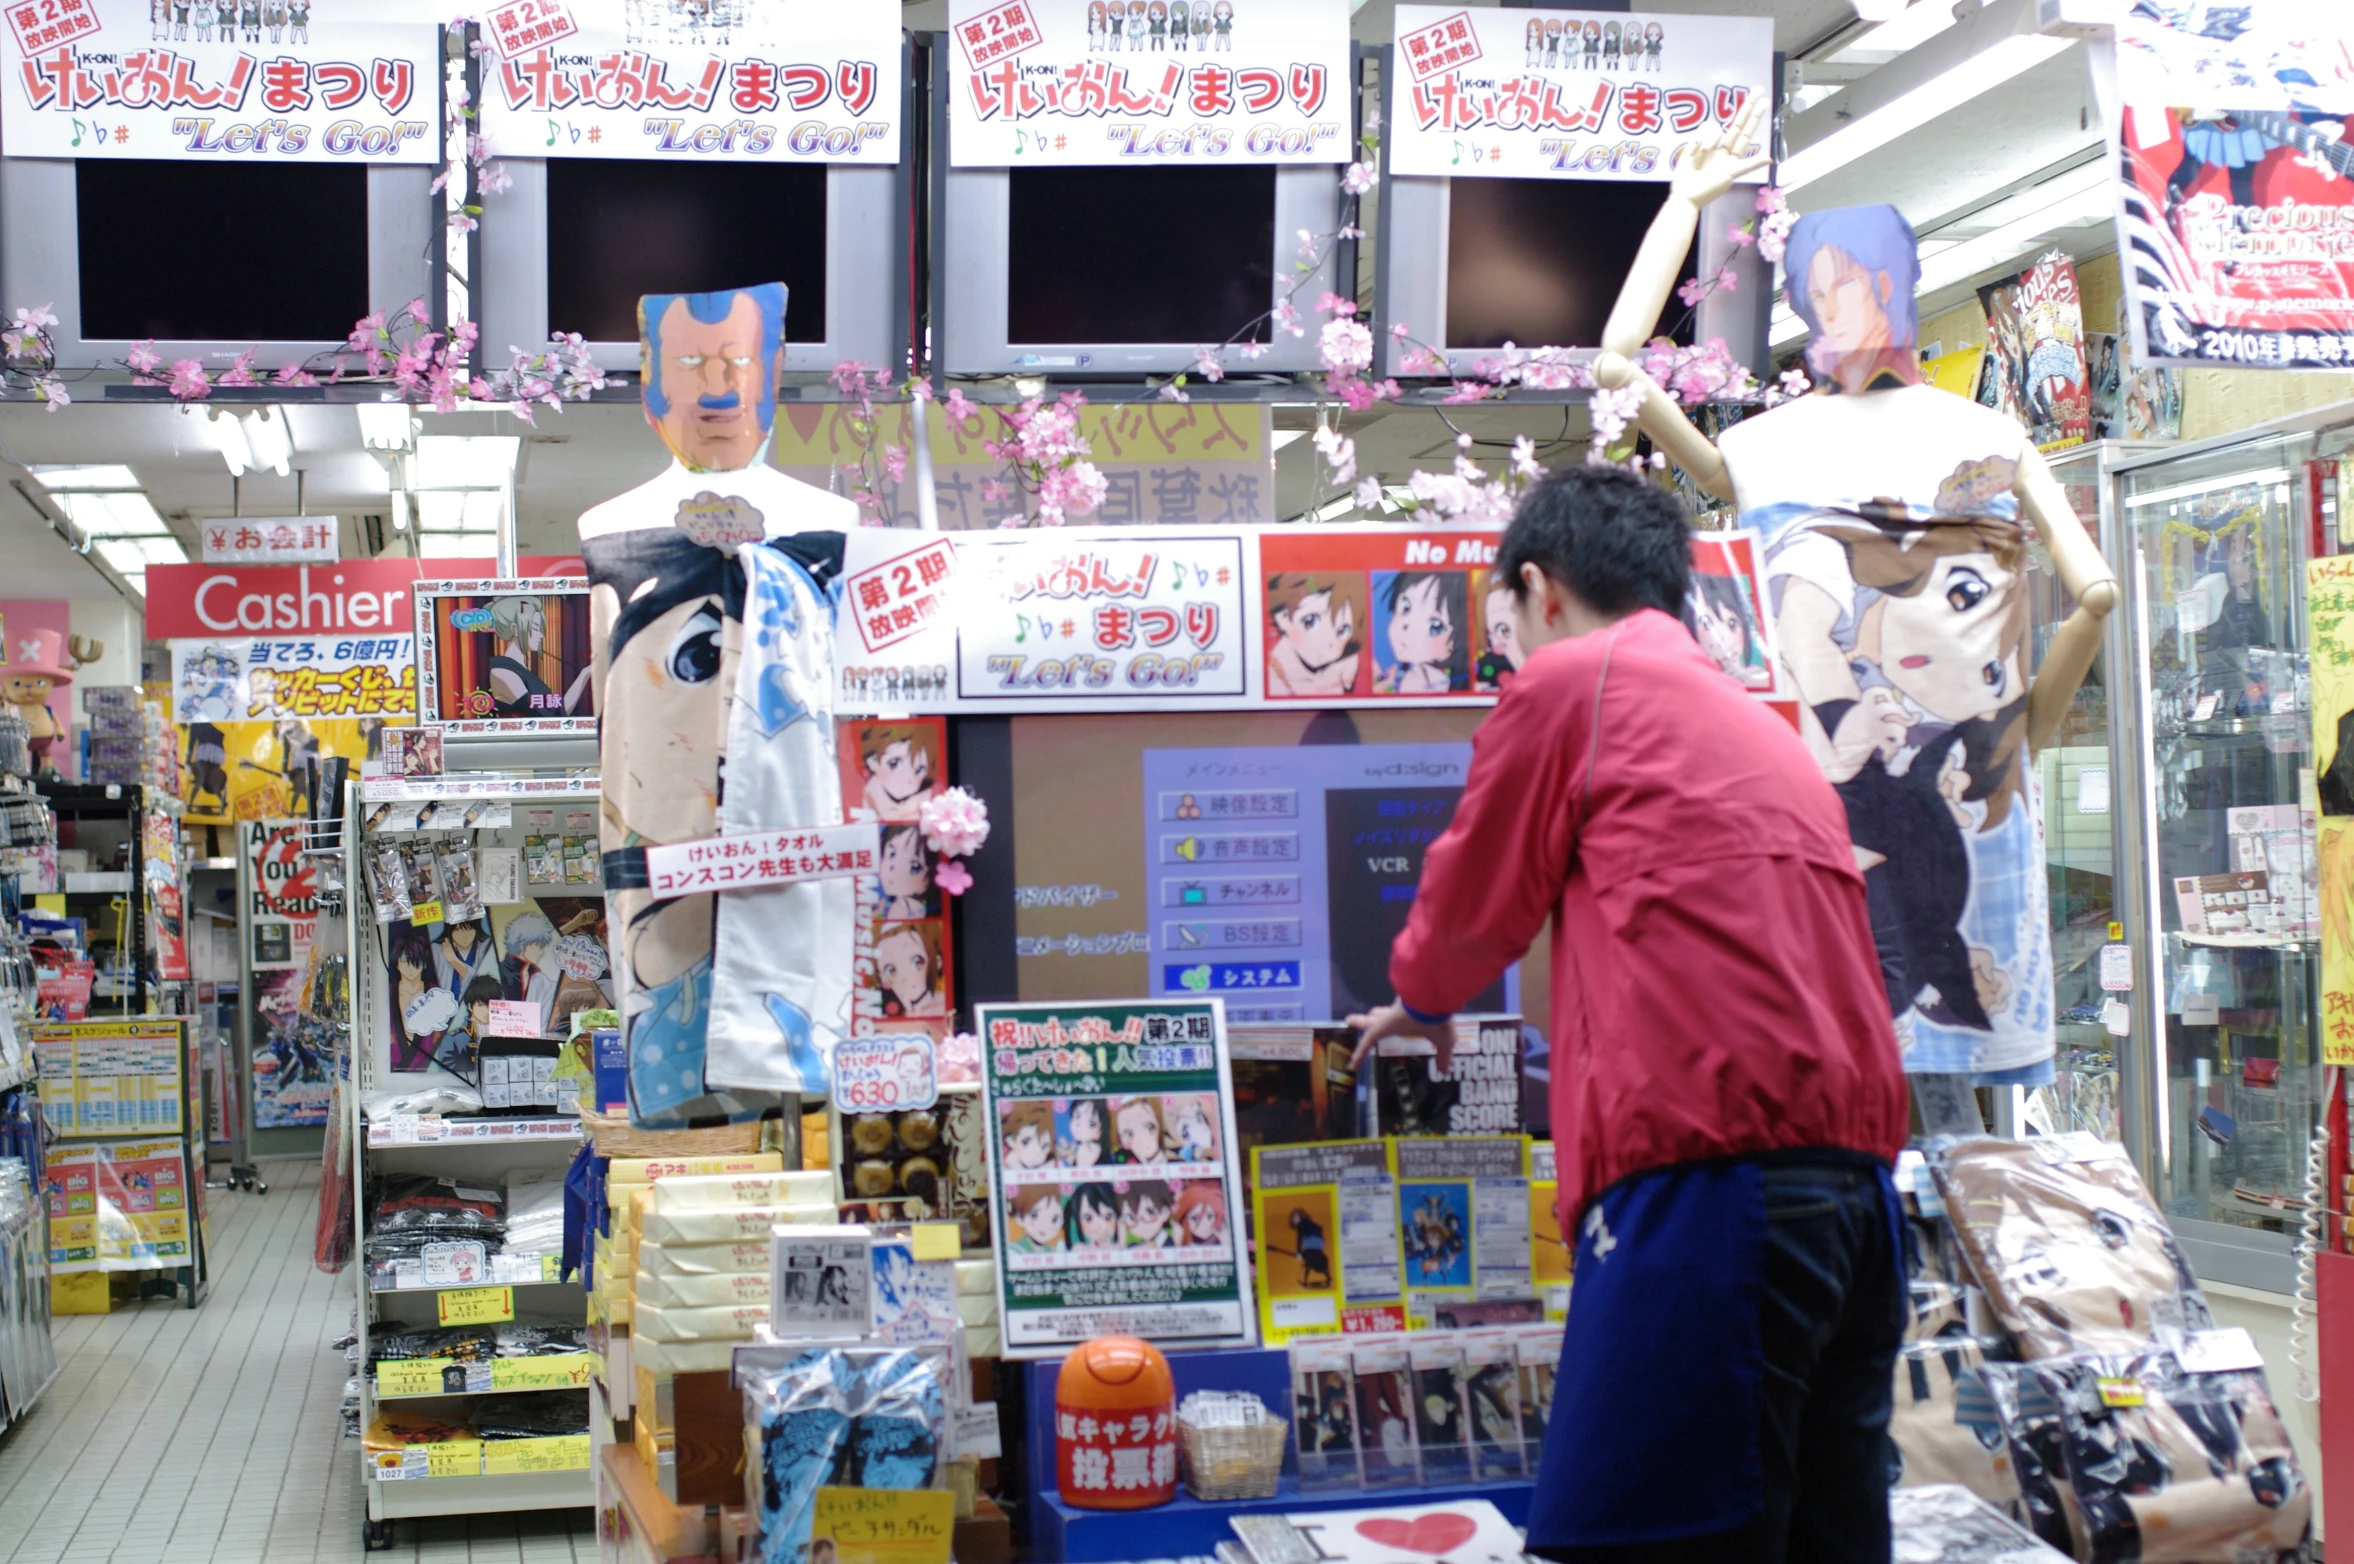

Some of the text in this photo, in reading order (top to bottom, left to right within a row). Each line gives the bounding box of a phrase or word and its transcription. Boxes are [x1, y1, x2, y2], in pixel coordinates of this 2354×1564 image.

[963, 10, 1028, 46] 第2期
[1408, 20, 1468, 57] 第2期
[82, 54, 117, 64] K-ON!
[559, 56, 593, 66] K-ON!
[1025, 67, 1057, 75] K-ON!
[1465, 80, 1495, 88] K-ON!
[234, 524, 332, 551] お会計
[1405, 541, 1446, 564] No
[194, 572, 405, 632] Cashier
[1093, 604, 1219, 650] まつり
[529, 694, 563, 709] 月詠
[1187, 763, 1283, 777] メインメニュー
[658, 850, 873, 891] コンスコン先生も大満足
[1367, 857, 1409, 873] VCR
[1016, 886, 1117, 906] ドバイザー
[1220, 882, 1289, 898] チャンネル
[413, 905, 440, 920] 新作
[1224, 924, 1290, 943] BS設定
[1224, 967, 1292, 986] システム
[850, 1080, 898, 1105] 630
[1460, 1081, 1518, 1104] BAND
[1449, 1104, 1518, 1130] SCORE
[1058, 1413, 1176, 1444] 気キャラク
[380, 1470, 401, 1478] 1027
